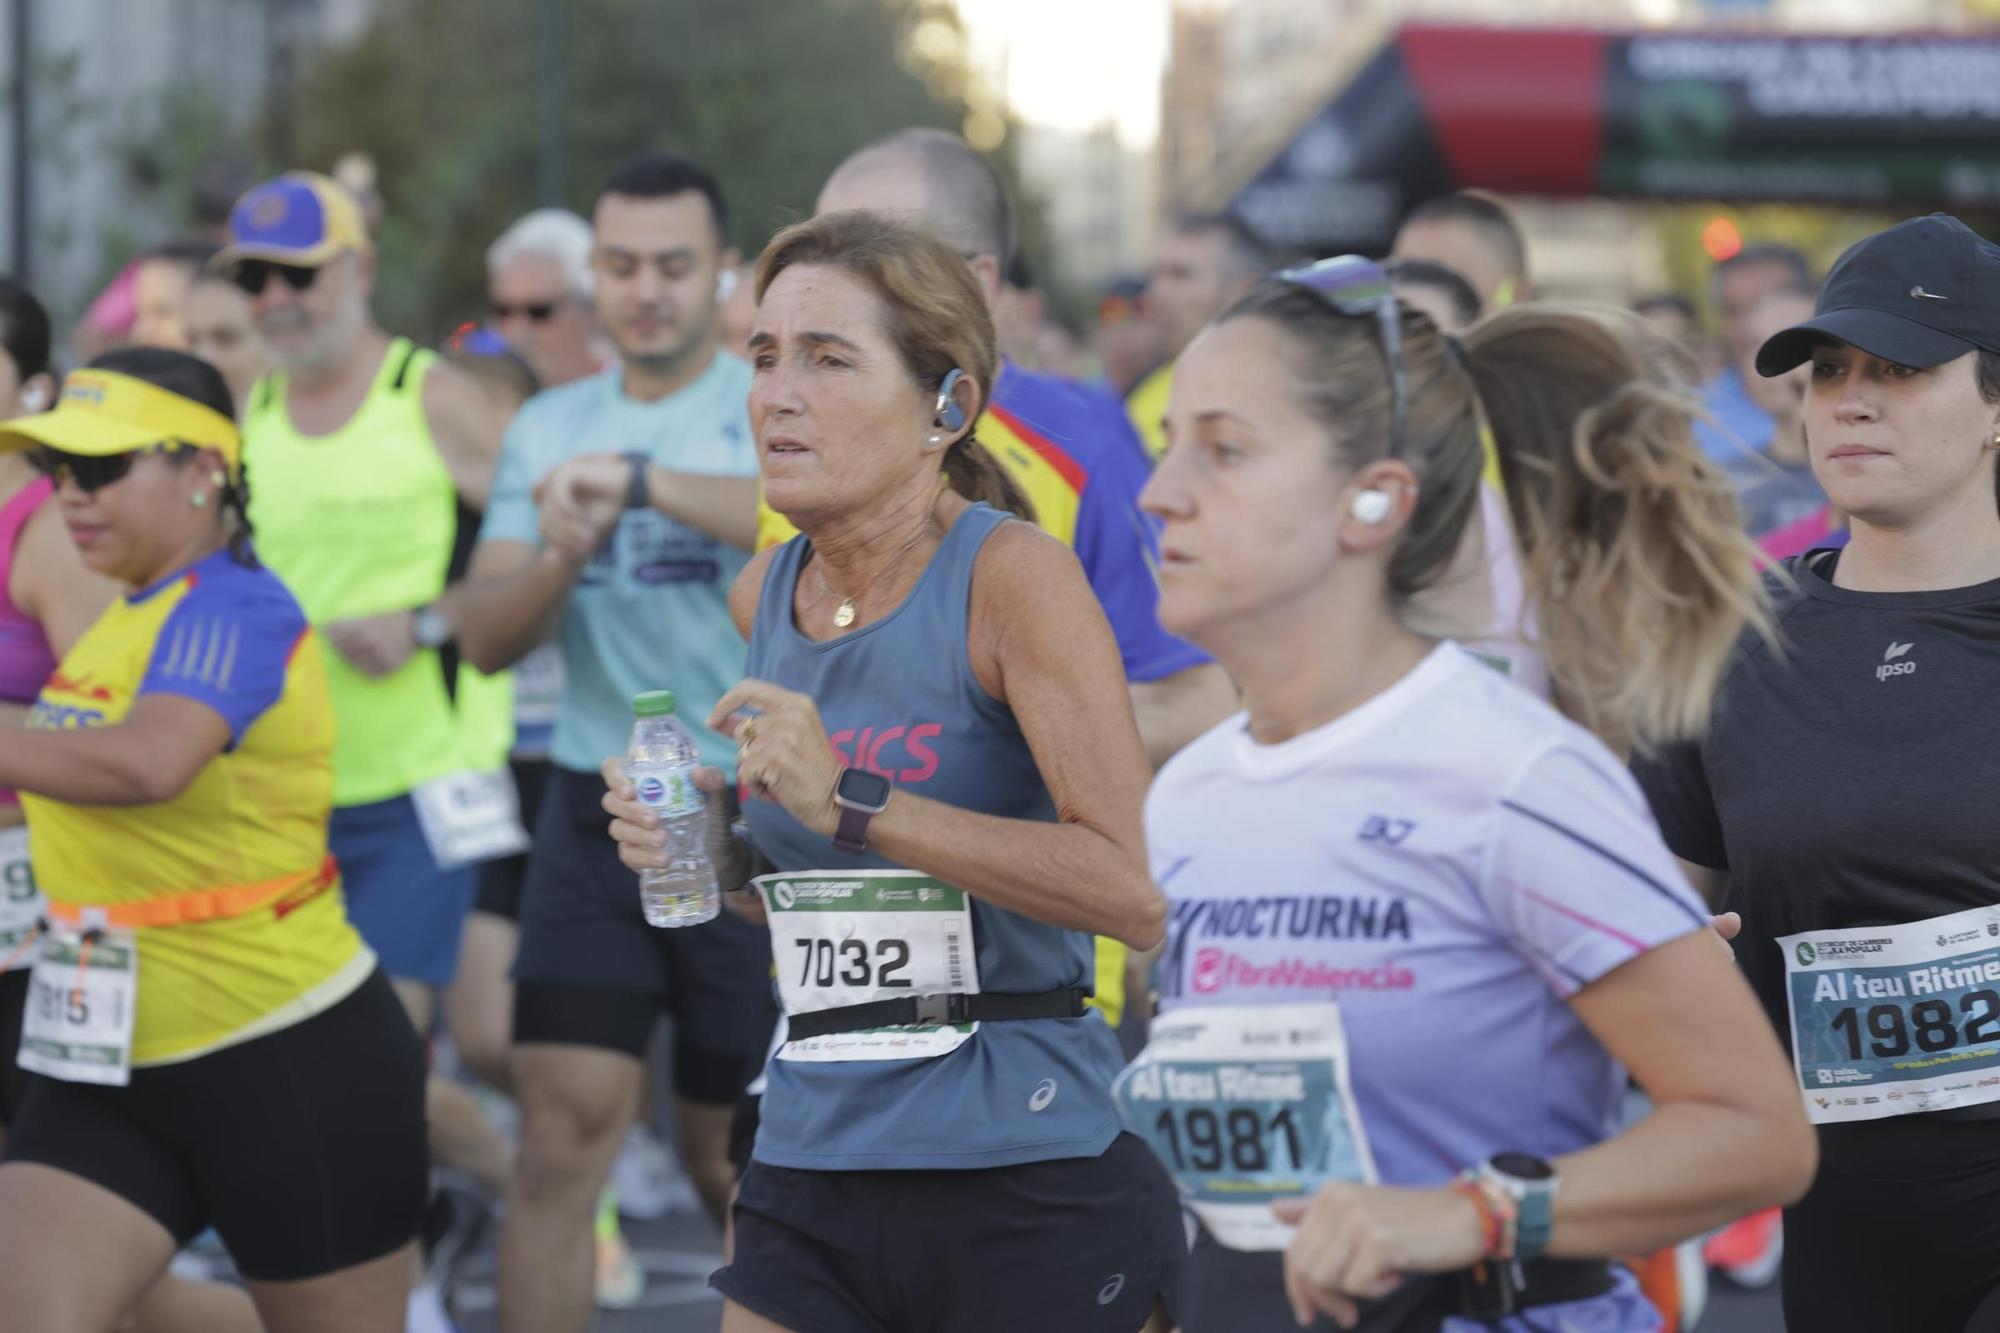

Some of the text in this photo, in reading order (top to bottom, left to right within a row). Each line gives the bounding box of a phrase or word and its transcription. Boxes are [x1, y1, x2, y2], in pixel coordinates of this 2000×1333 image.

[1876, 661, 1916, 682] ipso
[830, 723, 944, 783] SICS
[1201, 896, 1411, 940] NOCTURNA
[796, 938, 912, 988] 7032
[1814, 960, 2000, 1002] Al teu Ritme
[1832, 989, 2000, 1060] 1982
[1156, 1108, 1302, 1171] 1981
